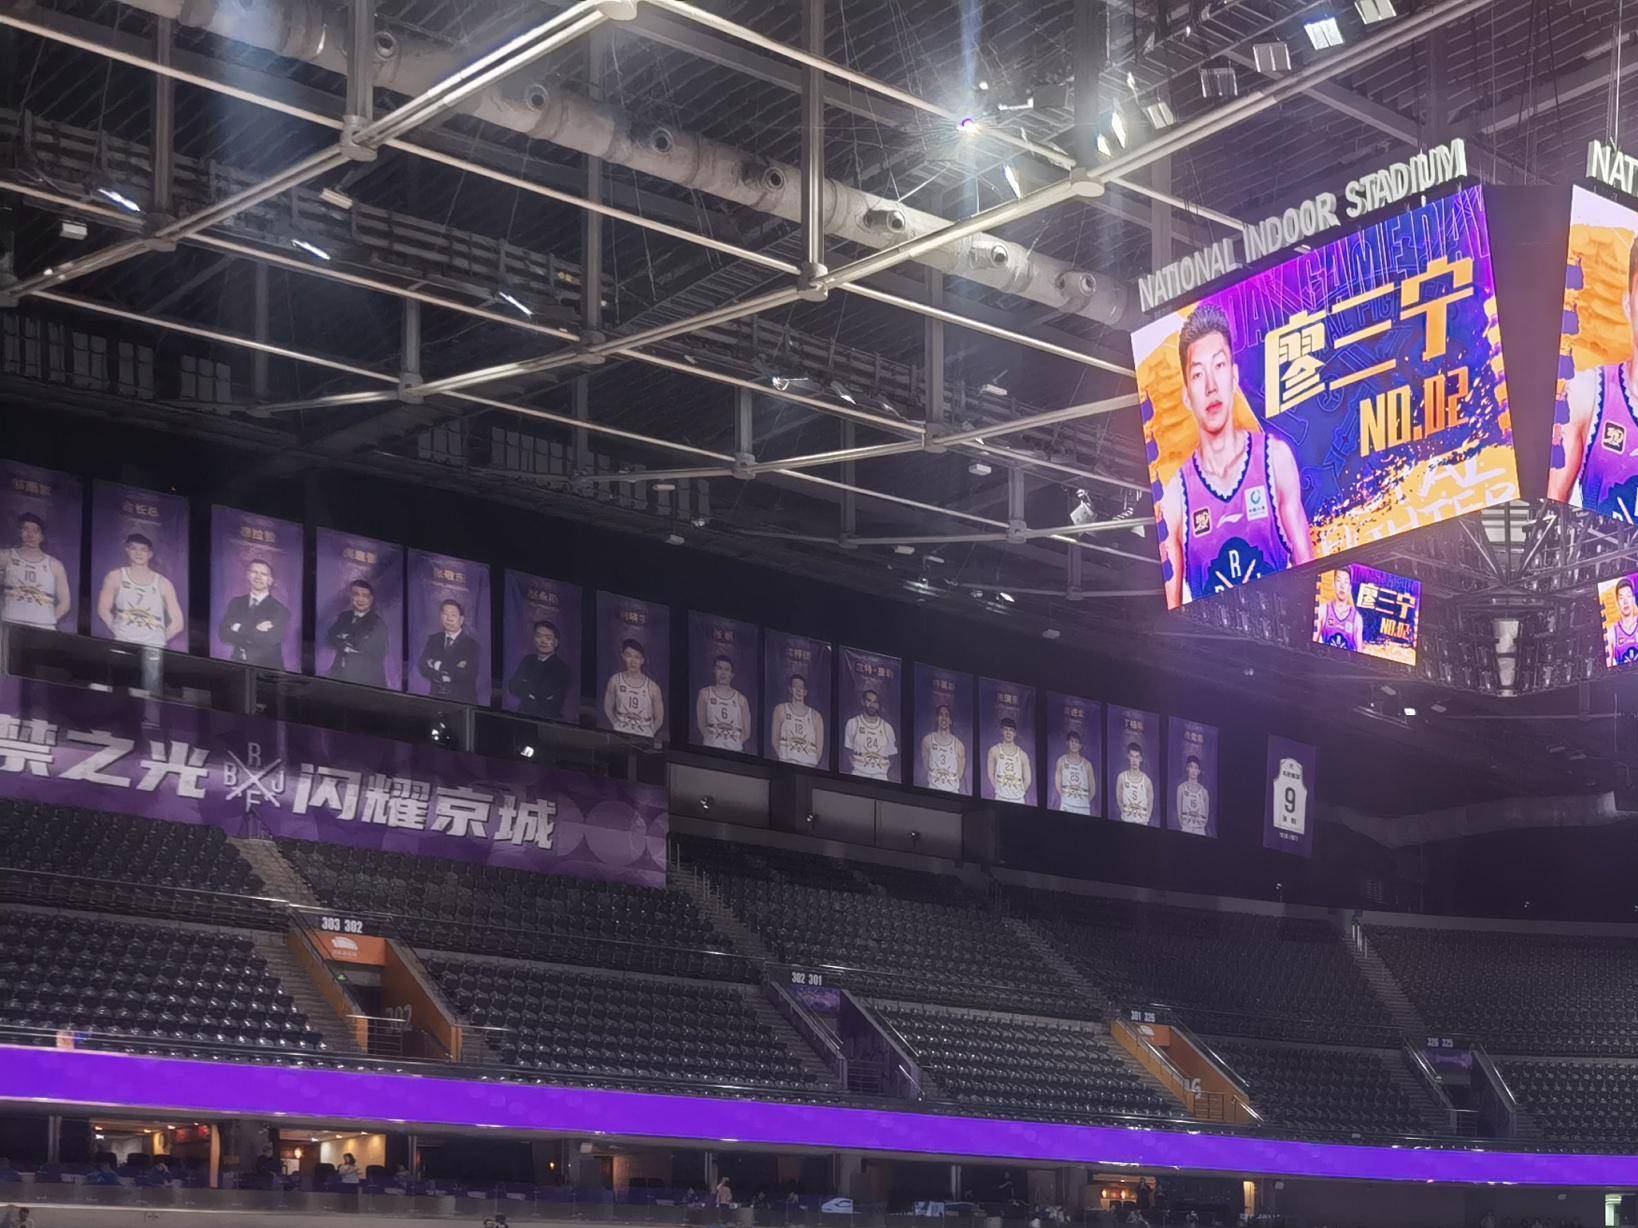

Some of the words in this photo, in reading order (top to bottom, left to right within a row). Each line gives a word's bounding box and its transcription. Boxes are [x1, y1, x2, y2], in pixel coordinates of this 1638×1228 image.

[1139, 238, 1240, 311] NATIONAL
[1243, 192, 1341, 263] INDOOR
[1345, 138, 1468, 218] STADIUM
[1264, 255, 1475, 419] 廖三宁
[1359, 365, 1470, 458] NO.02
[293, 761, 557, 850] 闪耀京城
[1284, 786, 1296, 814] 9
[322, 917, 341, 931] 303
[792, 971, 806, 985] 302
[809, 973, 823, 986] 301
